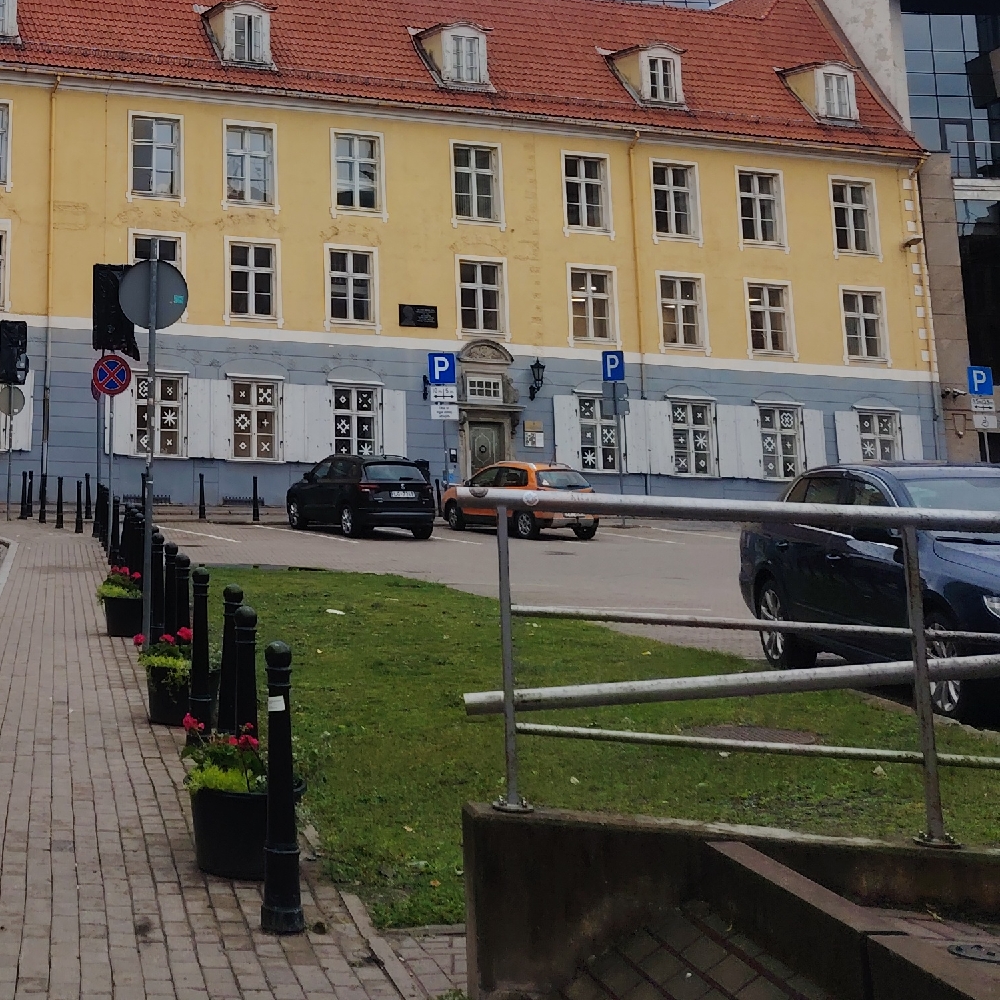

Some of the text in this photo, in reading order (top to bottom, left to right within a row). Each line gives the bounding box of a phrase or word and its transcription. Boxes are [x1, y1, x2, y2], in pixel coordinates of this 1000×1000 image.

[434, 356, 450, 380] P
[606, 355, 620, 378] P
[972, 370, 987, 392] P
